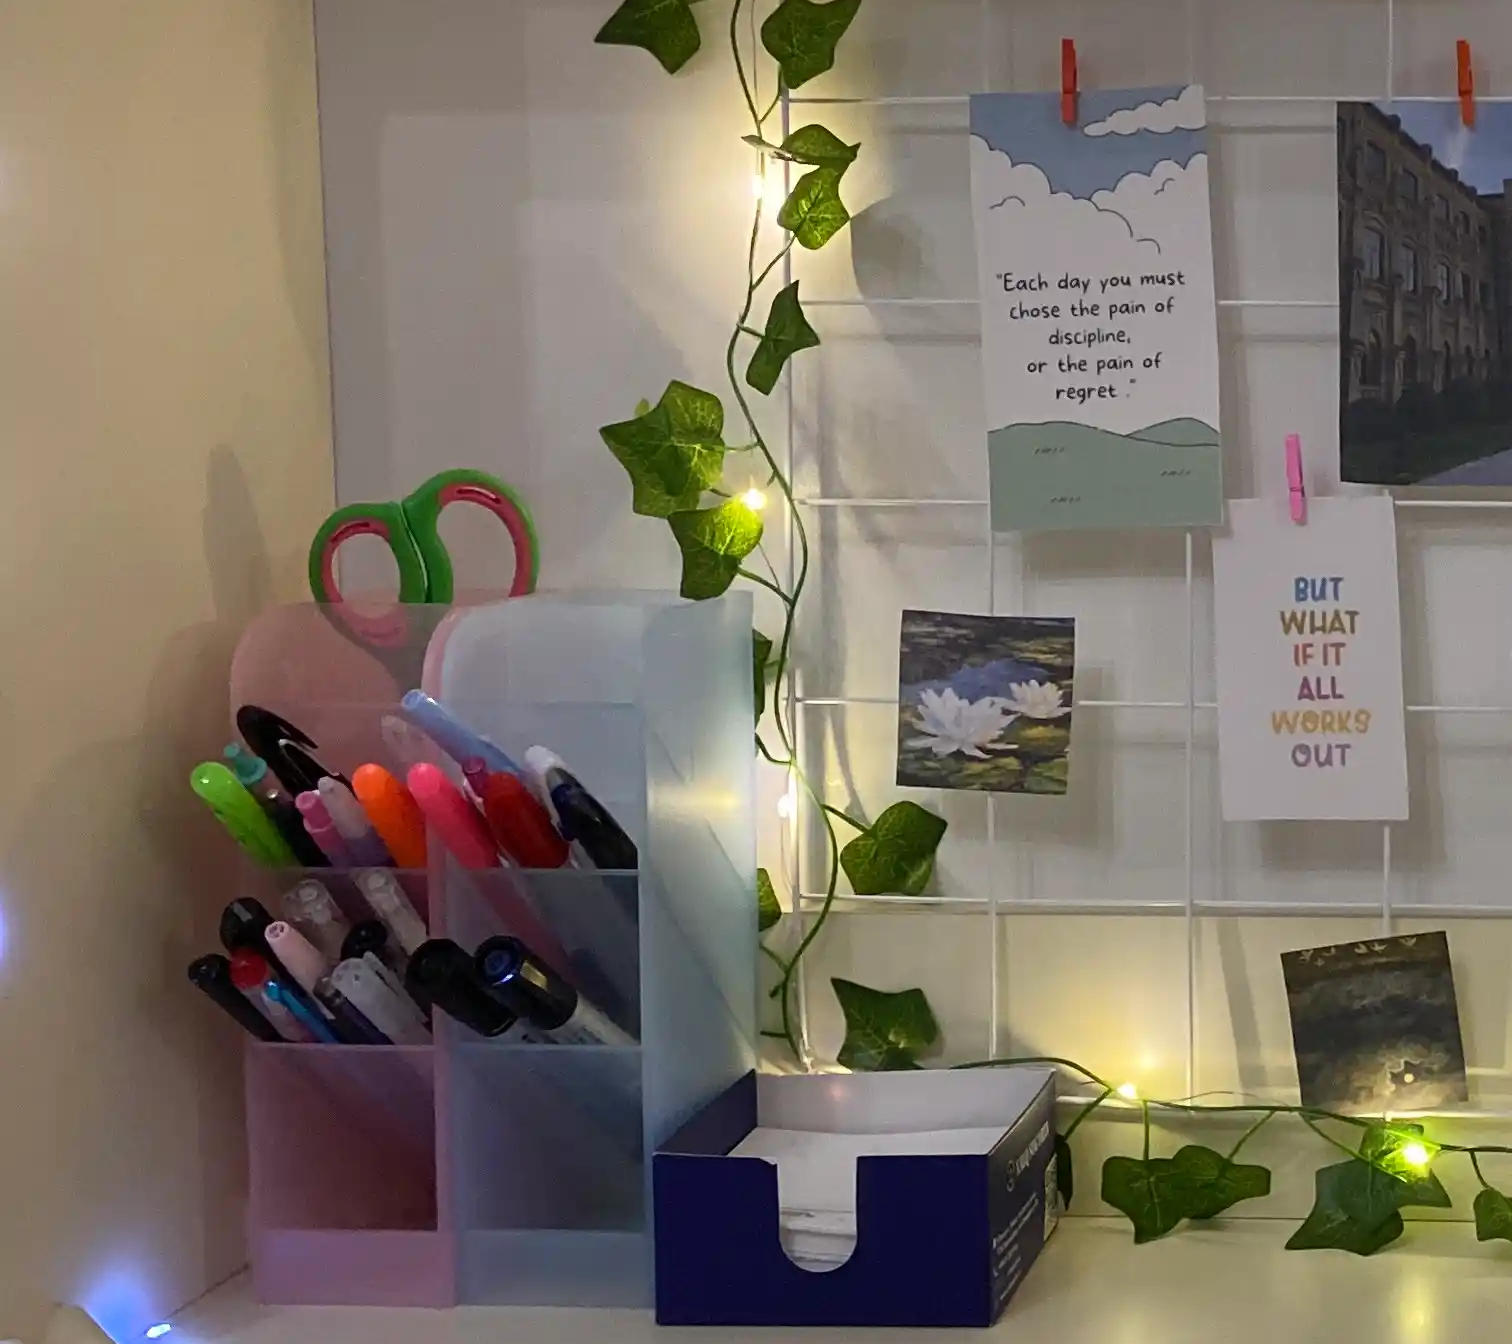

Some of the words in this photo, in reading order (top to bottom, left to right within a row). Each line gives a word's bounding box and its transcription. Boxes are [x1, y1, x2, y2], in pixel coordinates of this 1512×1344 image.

[996, 272, 1048, 292] "Each
[1057, 272, 1091, 293] day
[1100, 275, 1131, 294] you
[1140, 270, 1186, 287] must
[1010, 299, 1060, 320] chose
[1071, 298, 1100, 317] the
[1109, 299, 1146, 320] pain
[1154, 296, 1175, 314] of
[1027, 361, 1048, 374] or
[1058, 355, 1087, 373] the
[1096, 355, 1133, 375] pain
[1143, 352, 1163, 369] of
[1294, 576, 1344, 602] BUT
[1279, 610, 1360, 636] WHAT
[1293, 642, 1314, 667] IF
[1322, 642, 1346, 666] IT
[1297, 675, 1344, 701] ALL
[1271, 708, 1372, 735] WORKS
[1291, 743, 1352, 768] OUT
